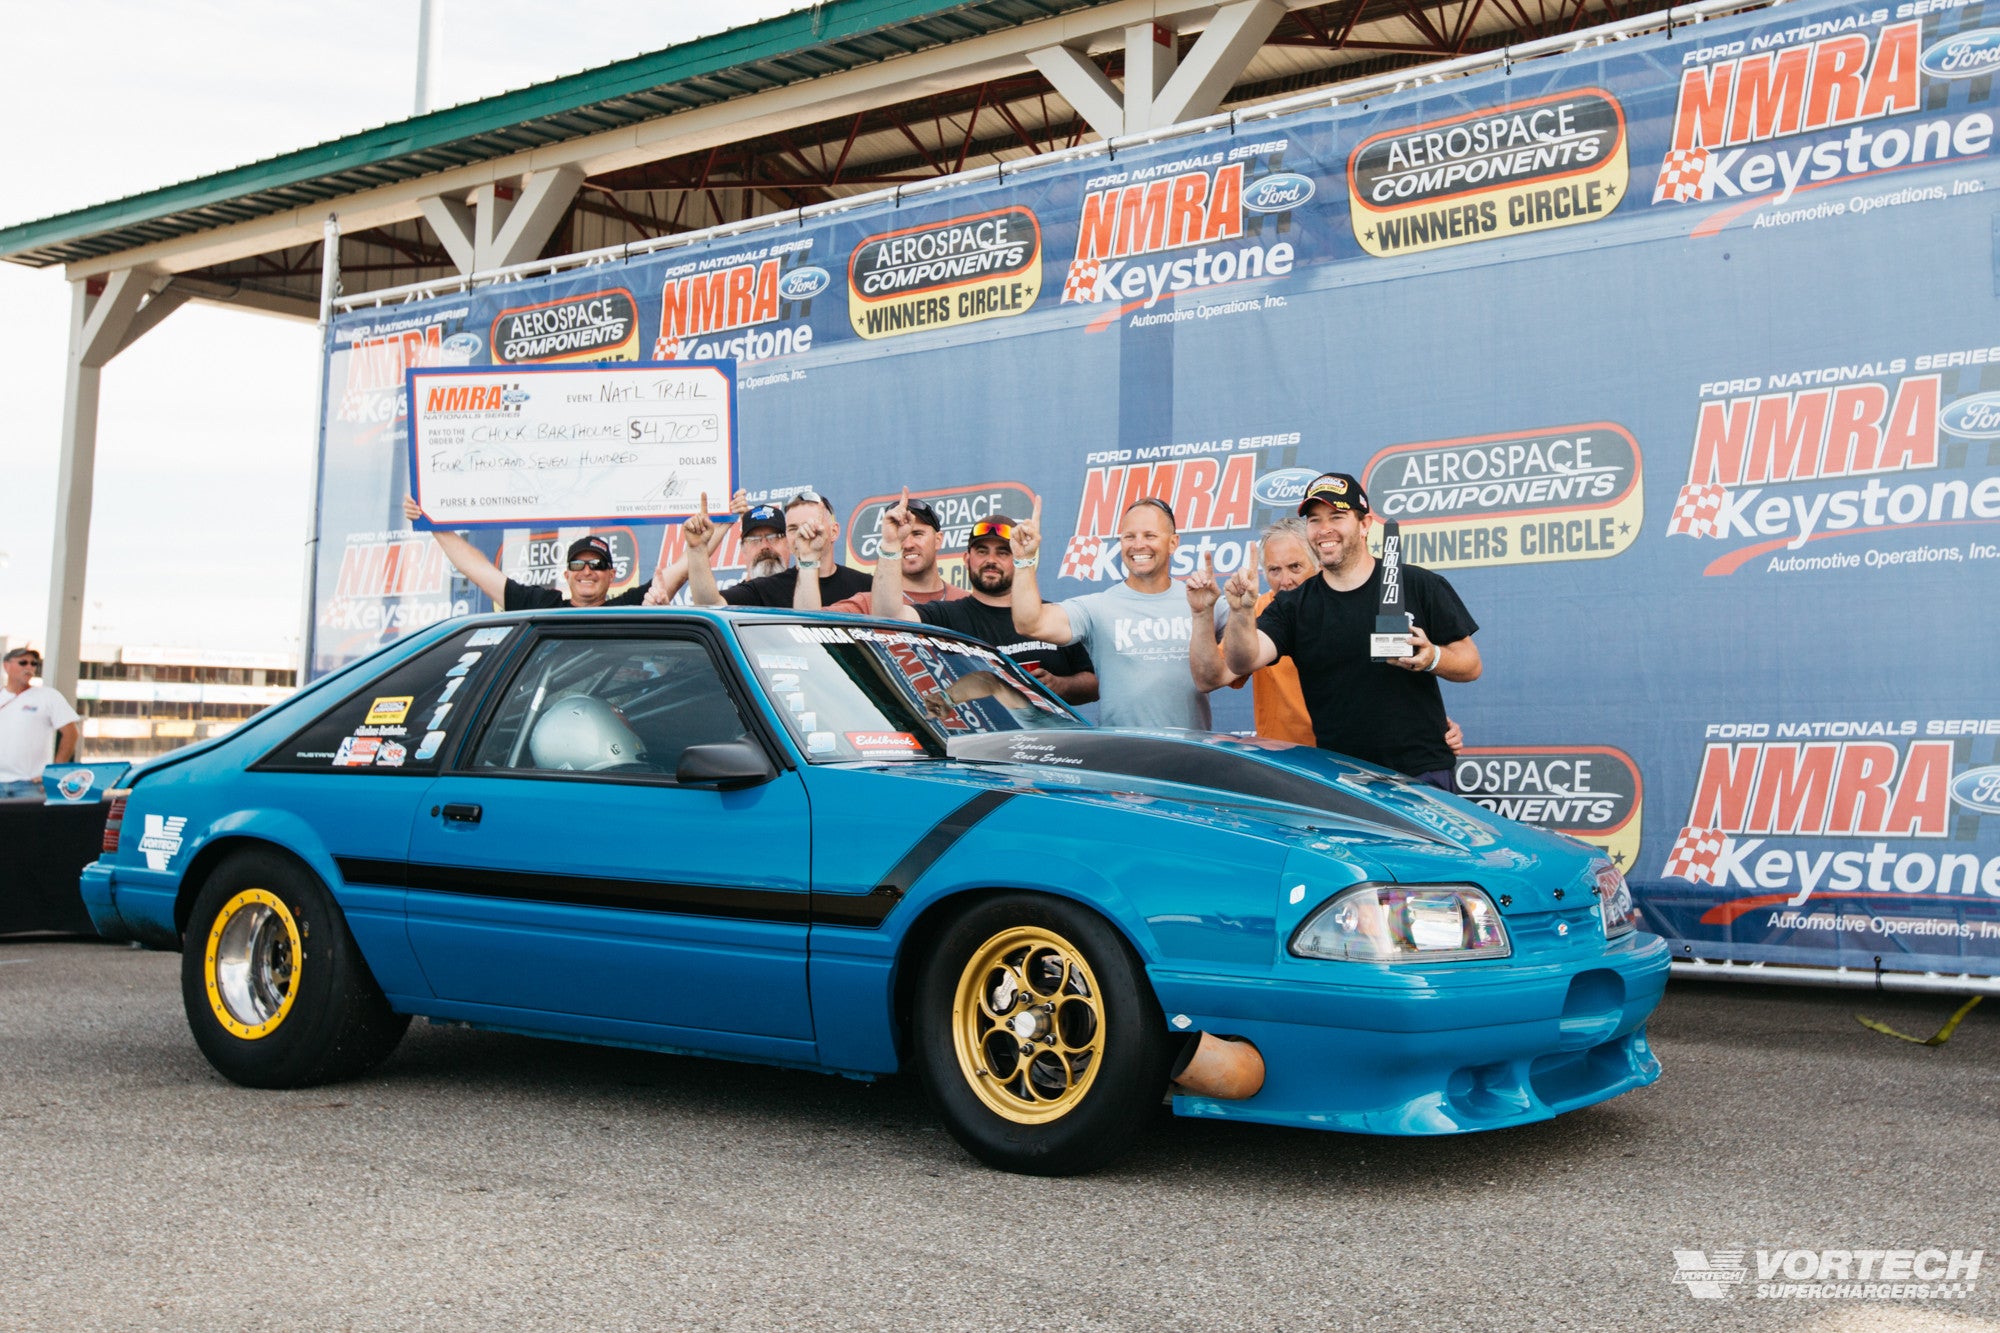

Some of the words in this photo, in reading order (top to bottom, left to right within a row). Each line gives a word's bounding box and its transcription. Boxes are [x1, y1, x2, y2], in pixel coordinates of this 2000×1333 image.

[1682, 40, 1745, 65] FORD
[1751, 9, 1888, 50] NATIONALS
[1671, 18, 1923, 151] NMRA
[1387, 103, 1576, 172] AEROSPACE
[1085, 171, 1128, 190] FORD
[1131, 154, 1223, 181] NATIONALS
[1228, 139, 1288, 161] SERIES
[1372, 137, 1601, 201] COMPONENTS
[1699, 112, 1994, 205] Keystone
[1074, 161, 1245, 265] NMRA
[1256, 180, 1300, 206] Ford
[1753, 202, 1845, 229] Automotive
[1849, 186, 1947, 214] Operations,
[1953, 179, 1985, 196] Inc.
[1376, 199, 1497, 251] WINNERS
[1508, 180, 1602, 227] CIRCLE
[665, 262, 696, 278] FORD
[698, 248, 767, 271] NATIONALS
[769, 238, 814, 255] SERIES
[876, 219, 1008, 269] AEROSPACE
[787, 273, 819, 294] Ford
[863, 246, 1025, 293] COMPONENTS
[1097, 242, 1294, 308] Keystone
[510, 299, 613, 339] AEROSPACE
[659, 257, 781, 341] NMRA
[866, 295, 950, 335] WINNERS
[958, 282, 1023, 318] CIRCLE
[1129, 306, 1195, 328] Automotive
[1197, 298, 1261, 320] Operations,
[1264, 295, 1288, 307] Inc.
[374, 315, 432, 334] NATIONALS
[433, 307, 470, 322] SERIES
[504, 322, 624, 361] COMPONENTS
[675, 324, 813, 363] Keystone
[652, 379, 708, 399] TRAIL
[746, 373, 790, 390] Operations,
[791, 368, 808, 380] Inc.
[1699, 377, 1761, 397] FORD
[1768, 358, 1906, 389] NATIONALS
[1914, 346, 2000, 371] SERIES
[426, 385, 502, 412] NMRA
[566, 393, 593, 403] EVENT
[1960, 401, 2000, 430] For
[429, 437, 453, 445] ORDER
[1087, 449, 1131, 464] FORD
[1136, 439, 1233, 459] NATIONALS
[1238, 432, 1301, 449] SERIES
[1687, 373, 1942, 487] NMRA
[679, 456, 717, 466] DOLLARS
[1401, 437, 1592, 487] AEROSPACE
[440, 498, 467, 507] PURSE
[470, 498, 477, 506] &
[480, 495, 539, 505] CONTINGENCY
[1383, 473, 1616, 515] COMPONENTS
[1714, 476, 2000, 550] Keystone
[1520, 517, 1615, 556] CIRCLE
[336, 539, 446, 596] NMRA
[1383, 536, 1400, 604] NMRA
[1767, 552, 1860, 573] Automotive
[1864, 545, 1964, 569] Operations,
[1968, 542, 2000, 559] Inc.
[347, 598, 469, 639] Keystone
[787, 627, 855, 643] NMRA
[855, 735, 915, 747] Edelbrock
[1705, 723, 1770, 738] FORD
[1776, 721, 1917, 737] NATIONALS
[1039, 753, 1084, 765] Engines
[1686, 740, 1955, 838] NMRA
[143, 838, 178, 851] VORTECH
[1766, 911, 1867, 934] Automotive
[1870, 915, 1976, 940] Operations,
